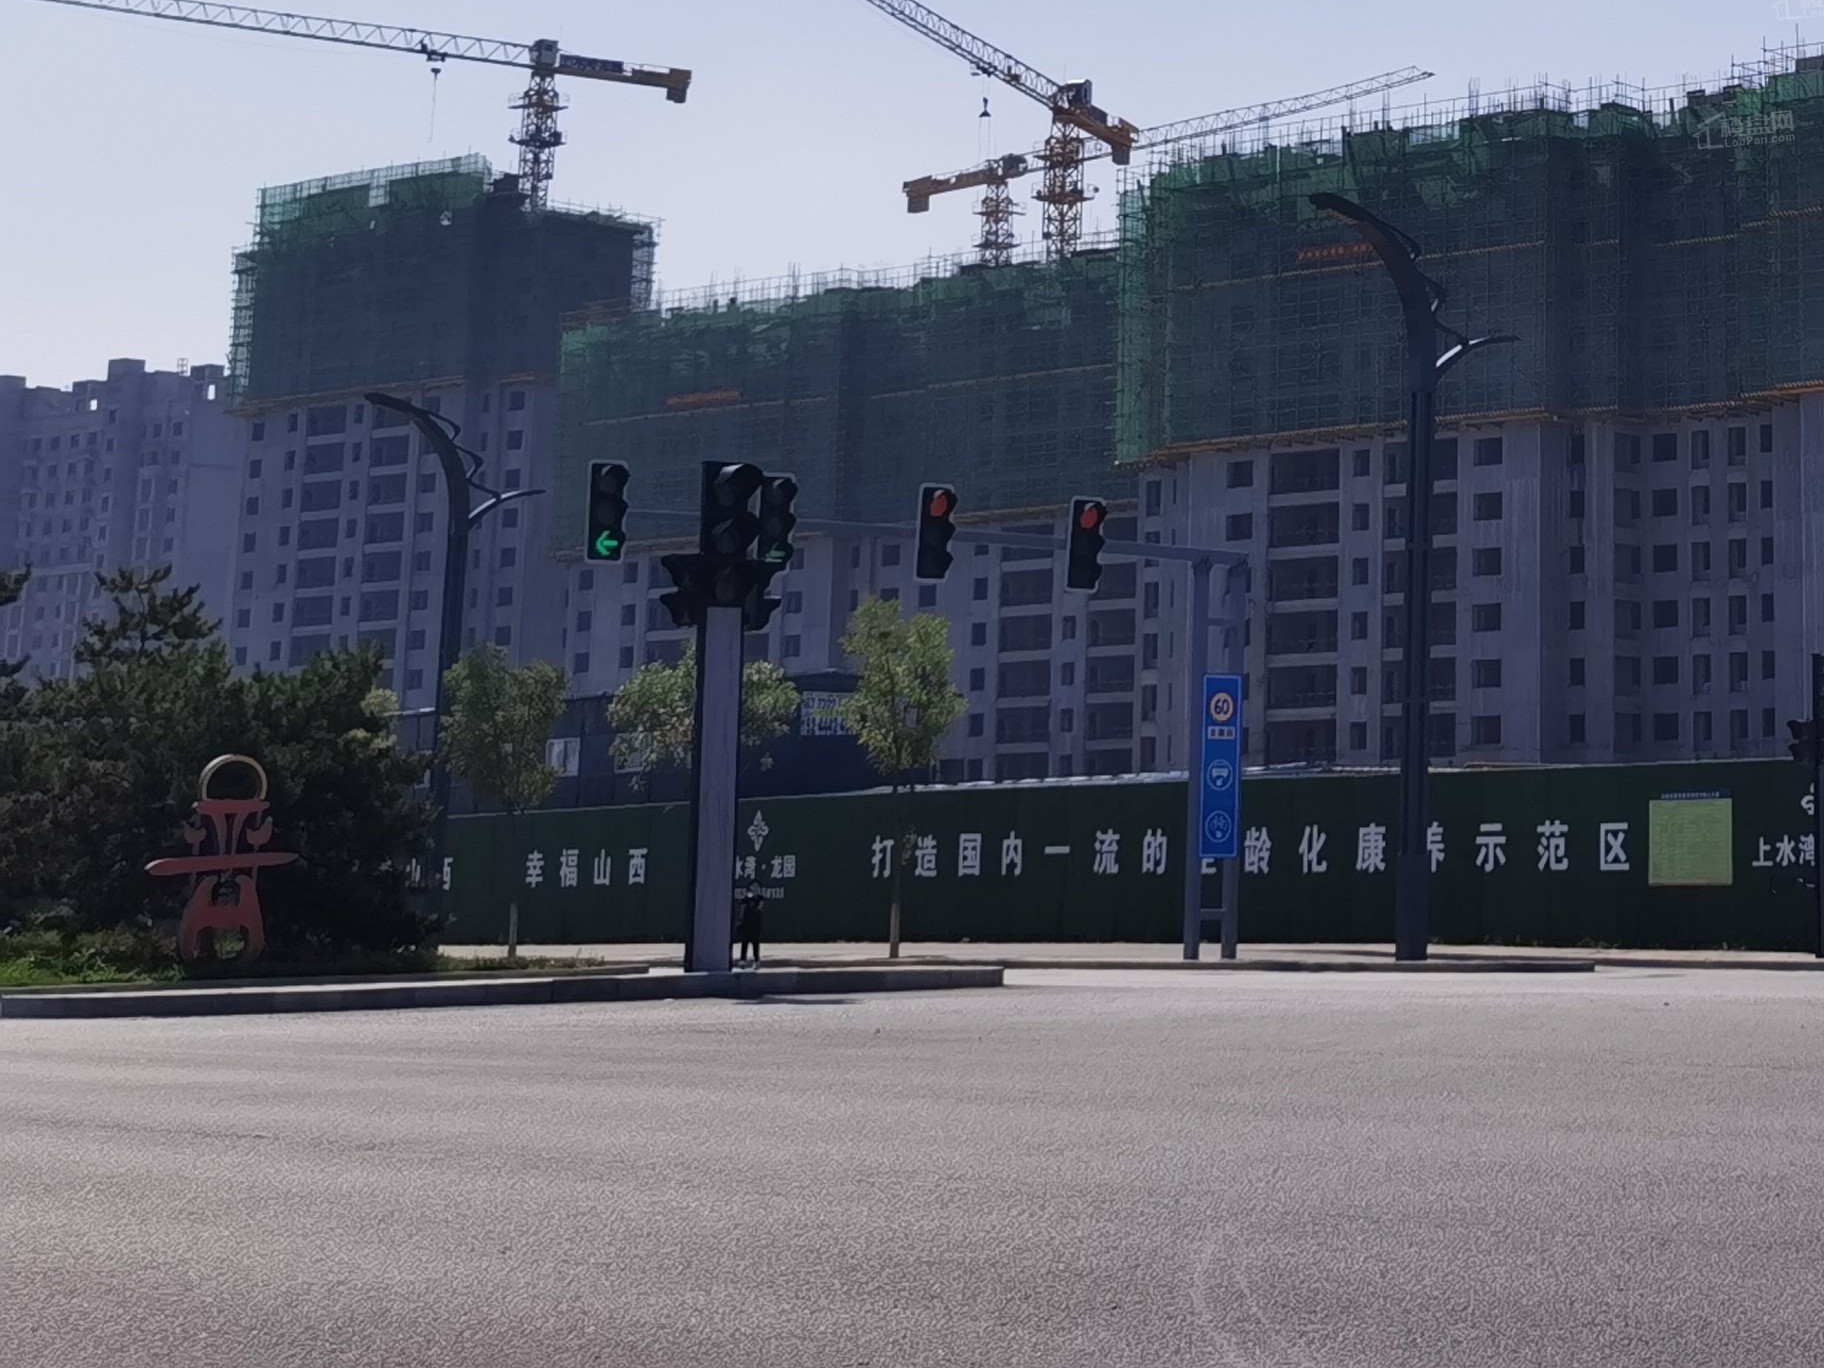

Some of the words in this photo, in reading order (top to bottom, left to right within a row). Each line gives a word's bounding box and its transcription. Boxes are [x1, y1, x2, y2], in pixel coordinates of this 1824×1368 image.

[1214, 697, 1230, 715] 60
[871, 819, 1631, 879] 打造国内一流的龄化康养示范区
[525, 847, 649, 888] 幸福山西
[735, 854, 797, 880] 水湾·龙园
